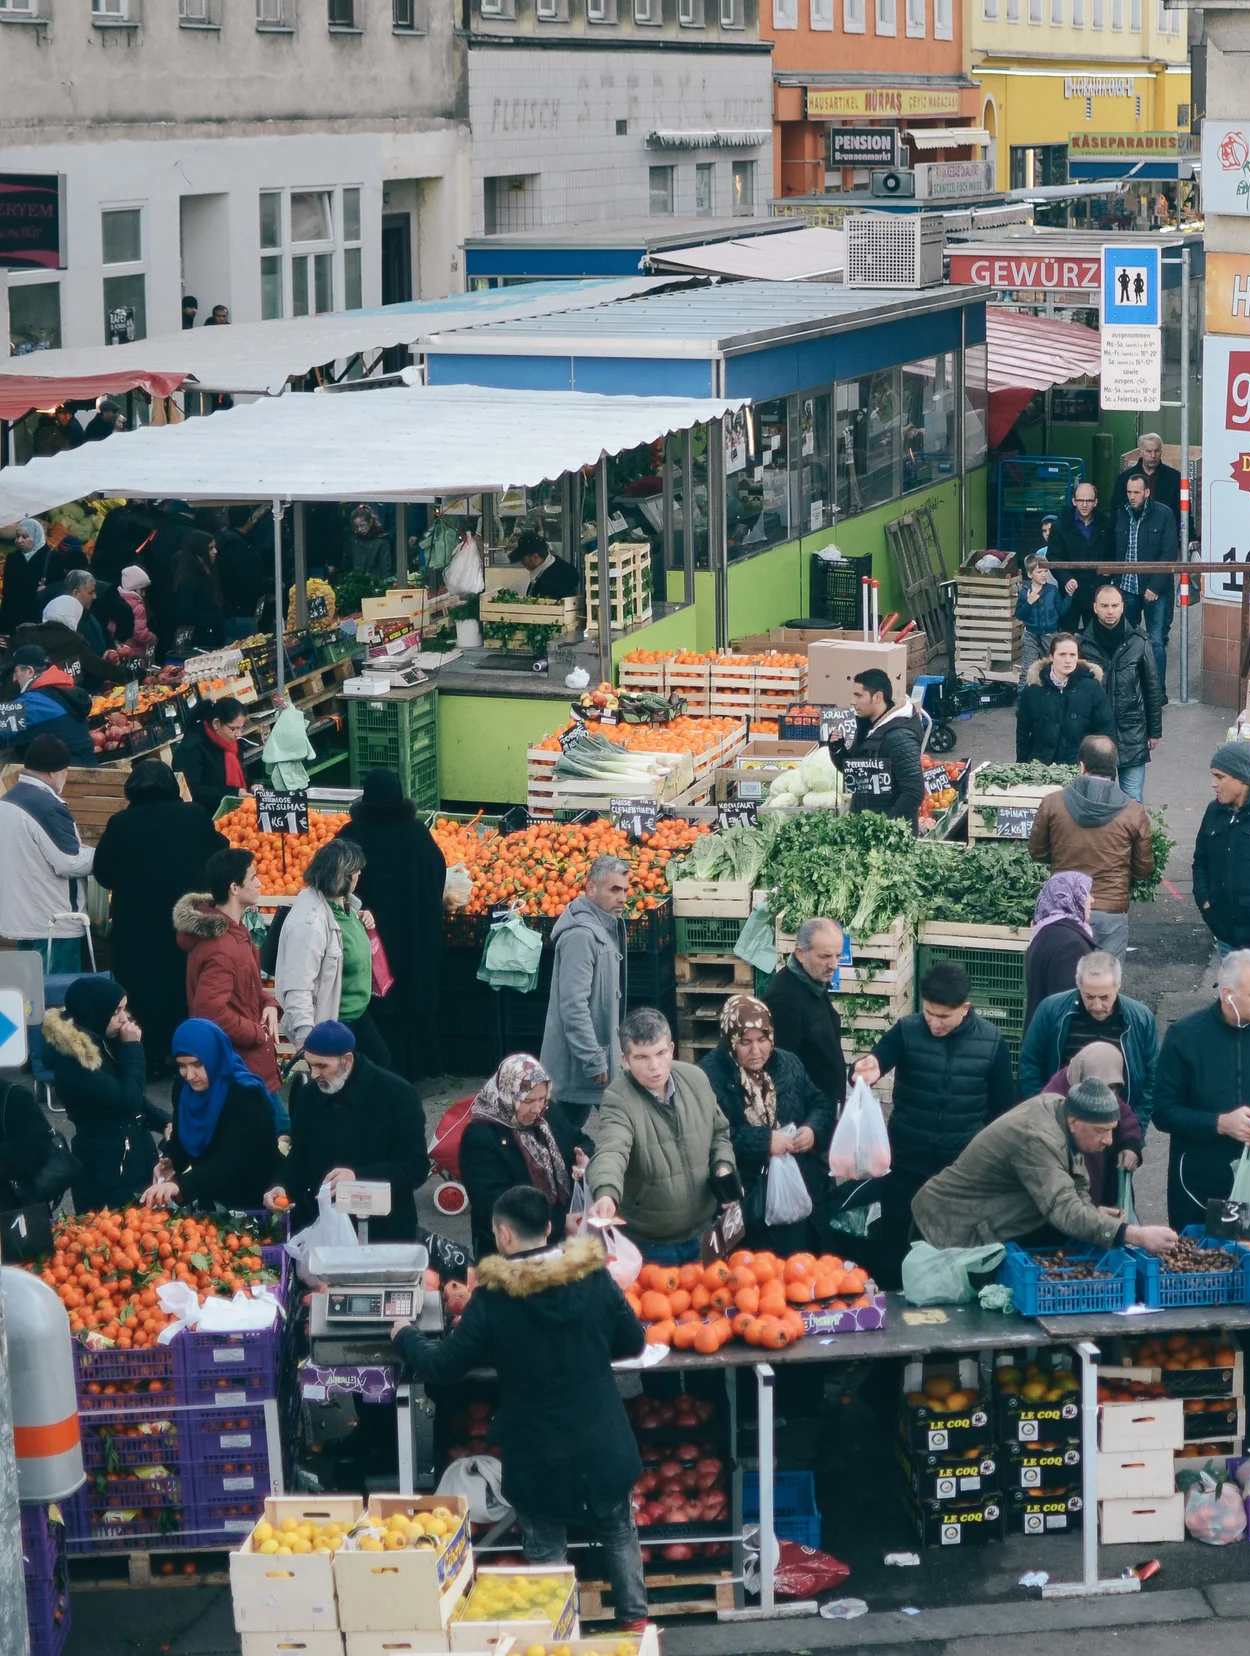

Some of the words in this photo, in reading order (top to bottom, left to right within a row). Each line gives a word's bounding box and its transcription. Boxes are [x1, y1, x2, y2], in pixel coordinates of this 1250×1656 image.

[808, 95, 859, 110] HAUSARTIKEL
[835, 135, 891, 150] PENSION
[1071, 134, 1177, 149] KÄSEPARADIES
[835, 151, 891, 162] Brunnenmarkt
[970, 258, 1099, 287] GEWÜRZ
[822, 710, 849, 719] KRAUT
[259, 803, 306, 811] SATSUMAS
[1000, 807, 1028, 819] SPINAT
[257, 812, 273, 833] 1
[271, 816, 284, 828] KG
[284, 812, 298, 834] 1
[299, 816, 309, 829] €
[620, 819, 631, 829] KG
[630, 815, 642, 836] 1
[644, 818, 657, 831] €
[719, 812, 729, 829] 1
[1011, 825, 1021, 834] KG
[10, 1213, 28, 1238] 1
[1021, 1411, 1035, 1420] LE
[1037, 1409, 1060, 1420] COQ
[930, 1421, 944, 1430] LE
[946, 1418, 970, 1429] COQ
[1023, 1458, 1037, 1467] LE
[1040, 1456, 1063, 1466] COQ
[939, 1468, 953, 1477] LE
[955, 1466, 979, 1476] COQ
[1026, 1505, 1041, 1513] LE
[1043, 1503, 1066, 1513] COQ
[943, 1515, 958, 1523] LE
[960, 1513, 983, 1523] COQ
